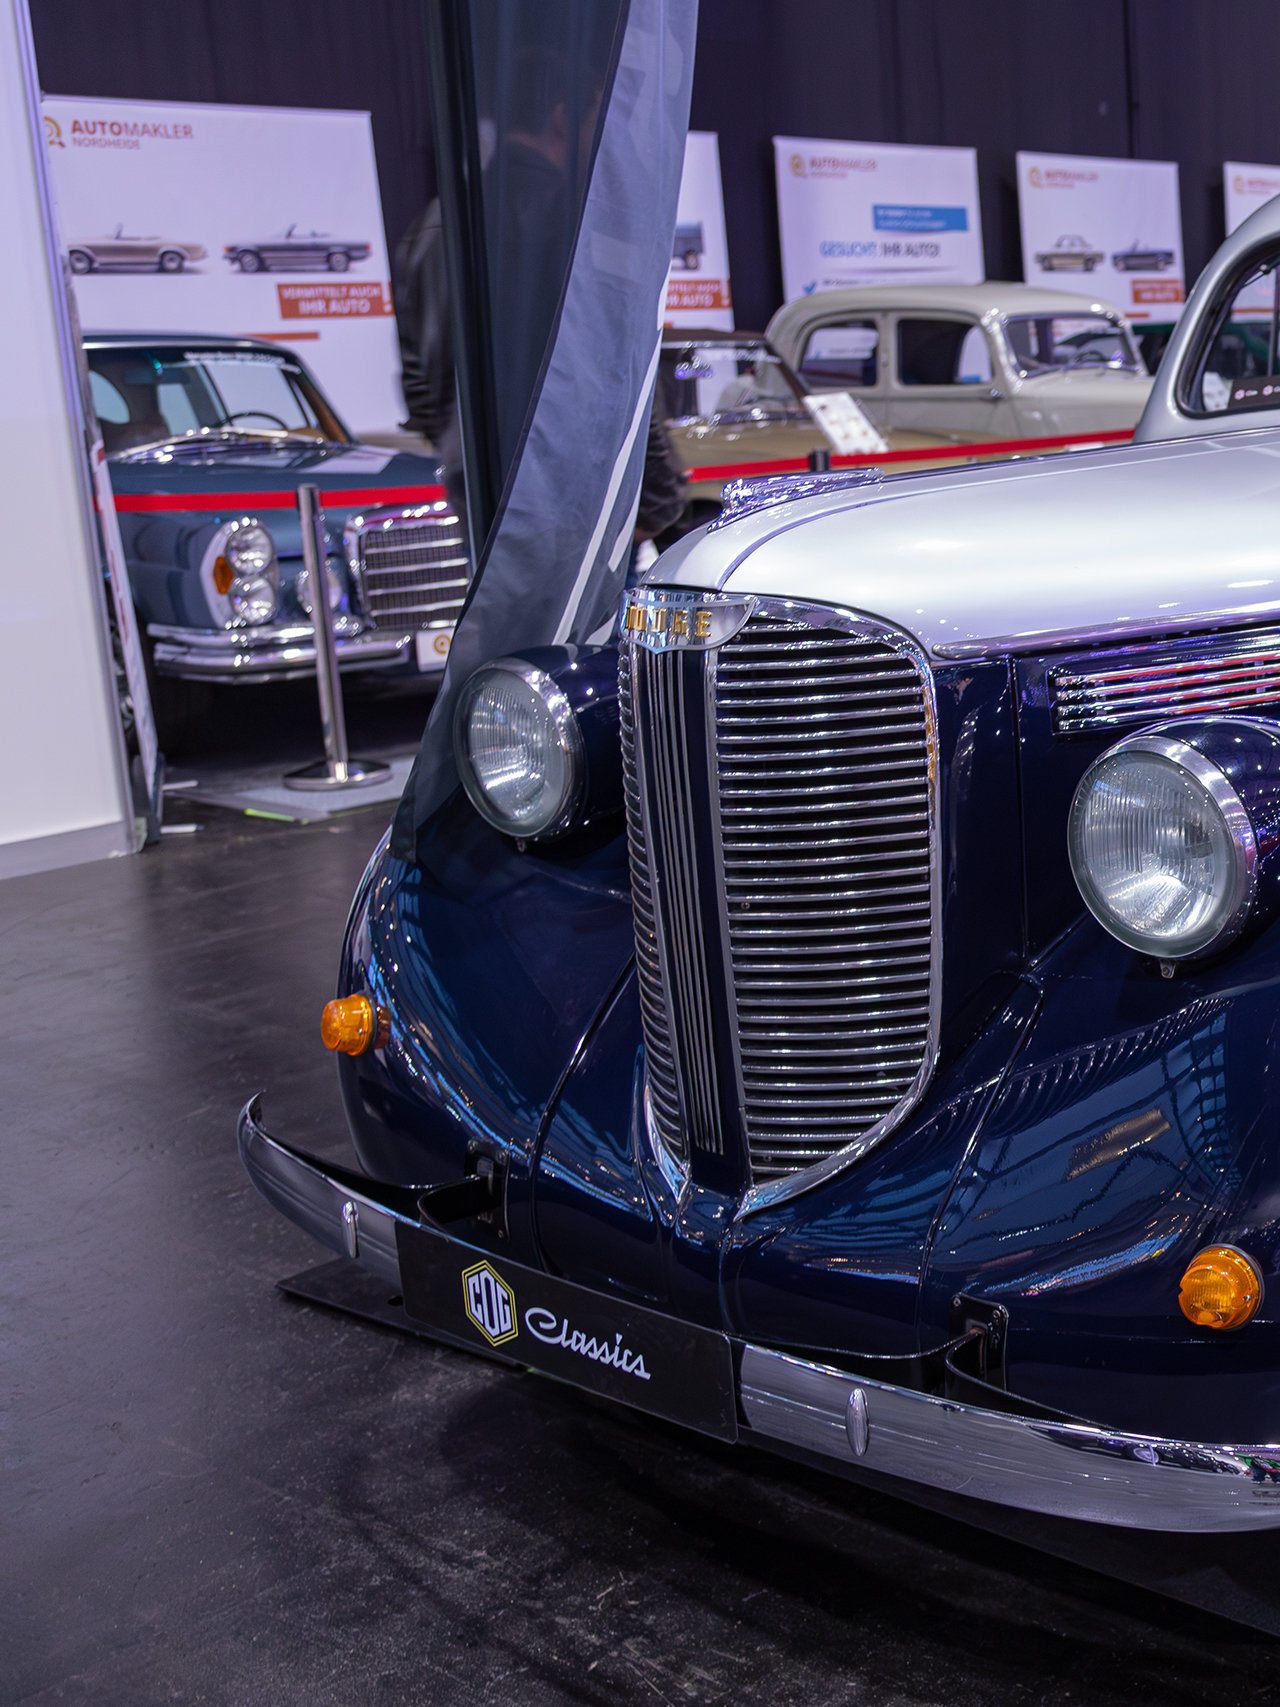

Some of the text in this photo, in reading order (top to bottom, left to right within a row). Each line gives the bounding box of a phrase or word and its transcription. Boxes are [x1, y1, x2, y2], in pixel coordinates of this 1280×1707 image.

[72, 119, 194, 139] AUTOMAKLER
[72, 137, 141, 150] NORDHEIDE
[298, 299, 327, 315] IHR
[524, 1306, 651, 1381] Classics
